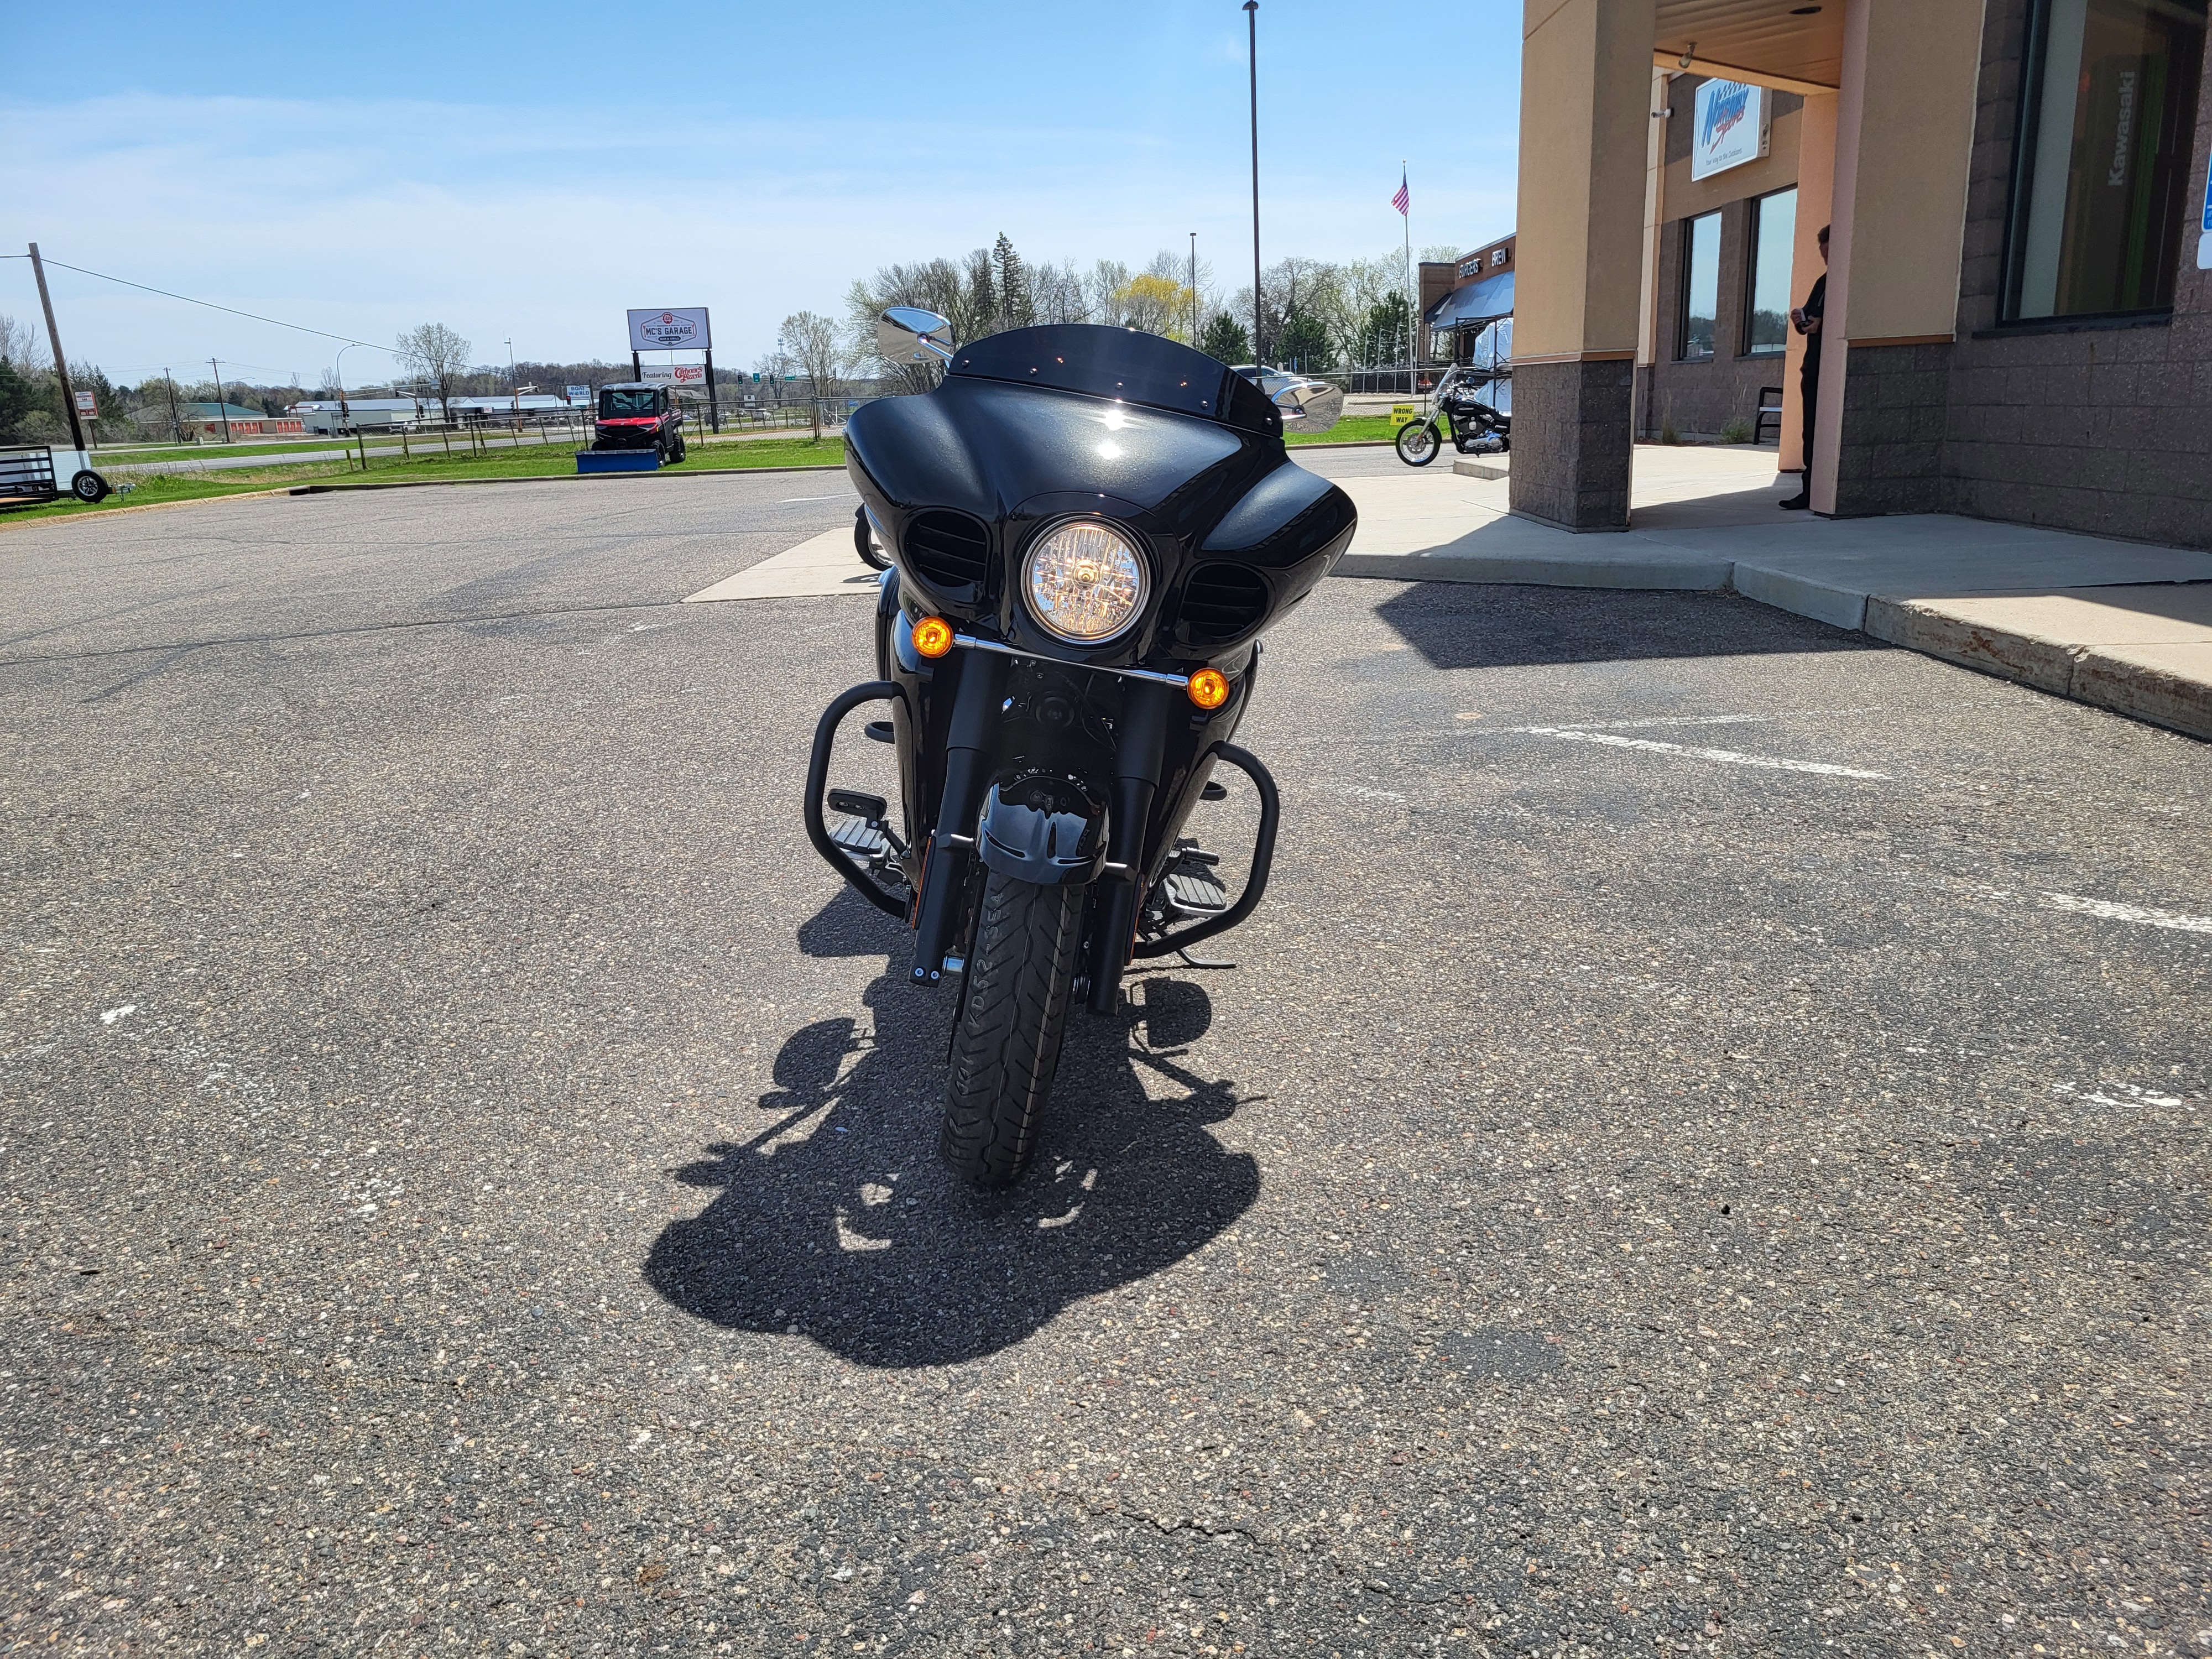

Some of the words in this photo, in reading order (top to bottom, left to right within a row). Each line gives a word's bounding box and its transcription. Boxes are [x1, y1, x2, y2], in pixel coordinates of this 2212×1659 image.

[2108, 71, 2135, 186] Kawasaki
[1459, 258, 1479, 279] BURGERS
[1491, 247, 1507, 267] BREW
[665, 326, 692, 335] GARAGE
[642, 371, 672, 380] Featuring
